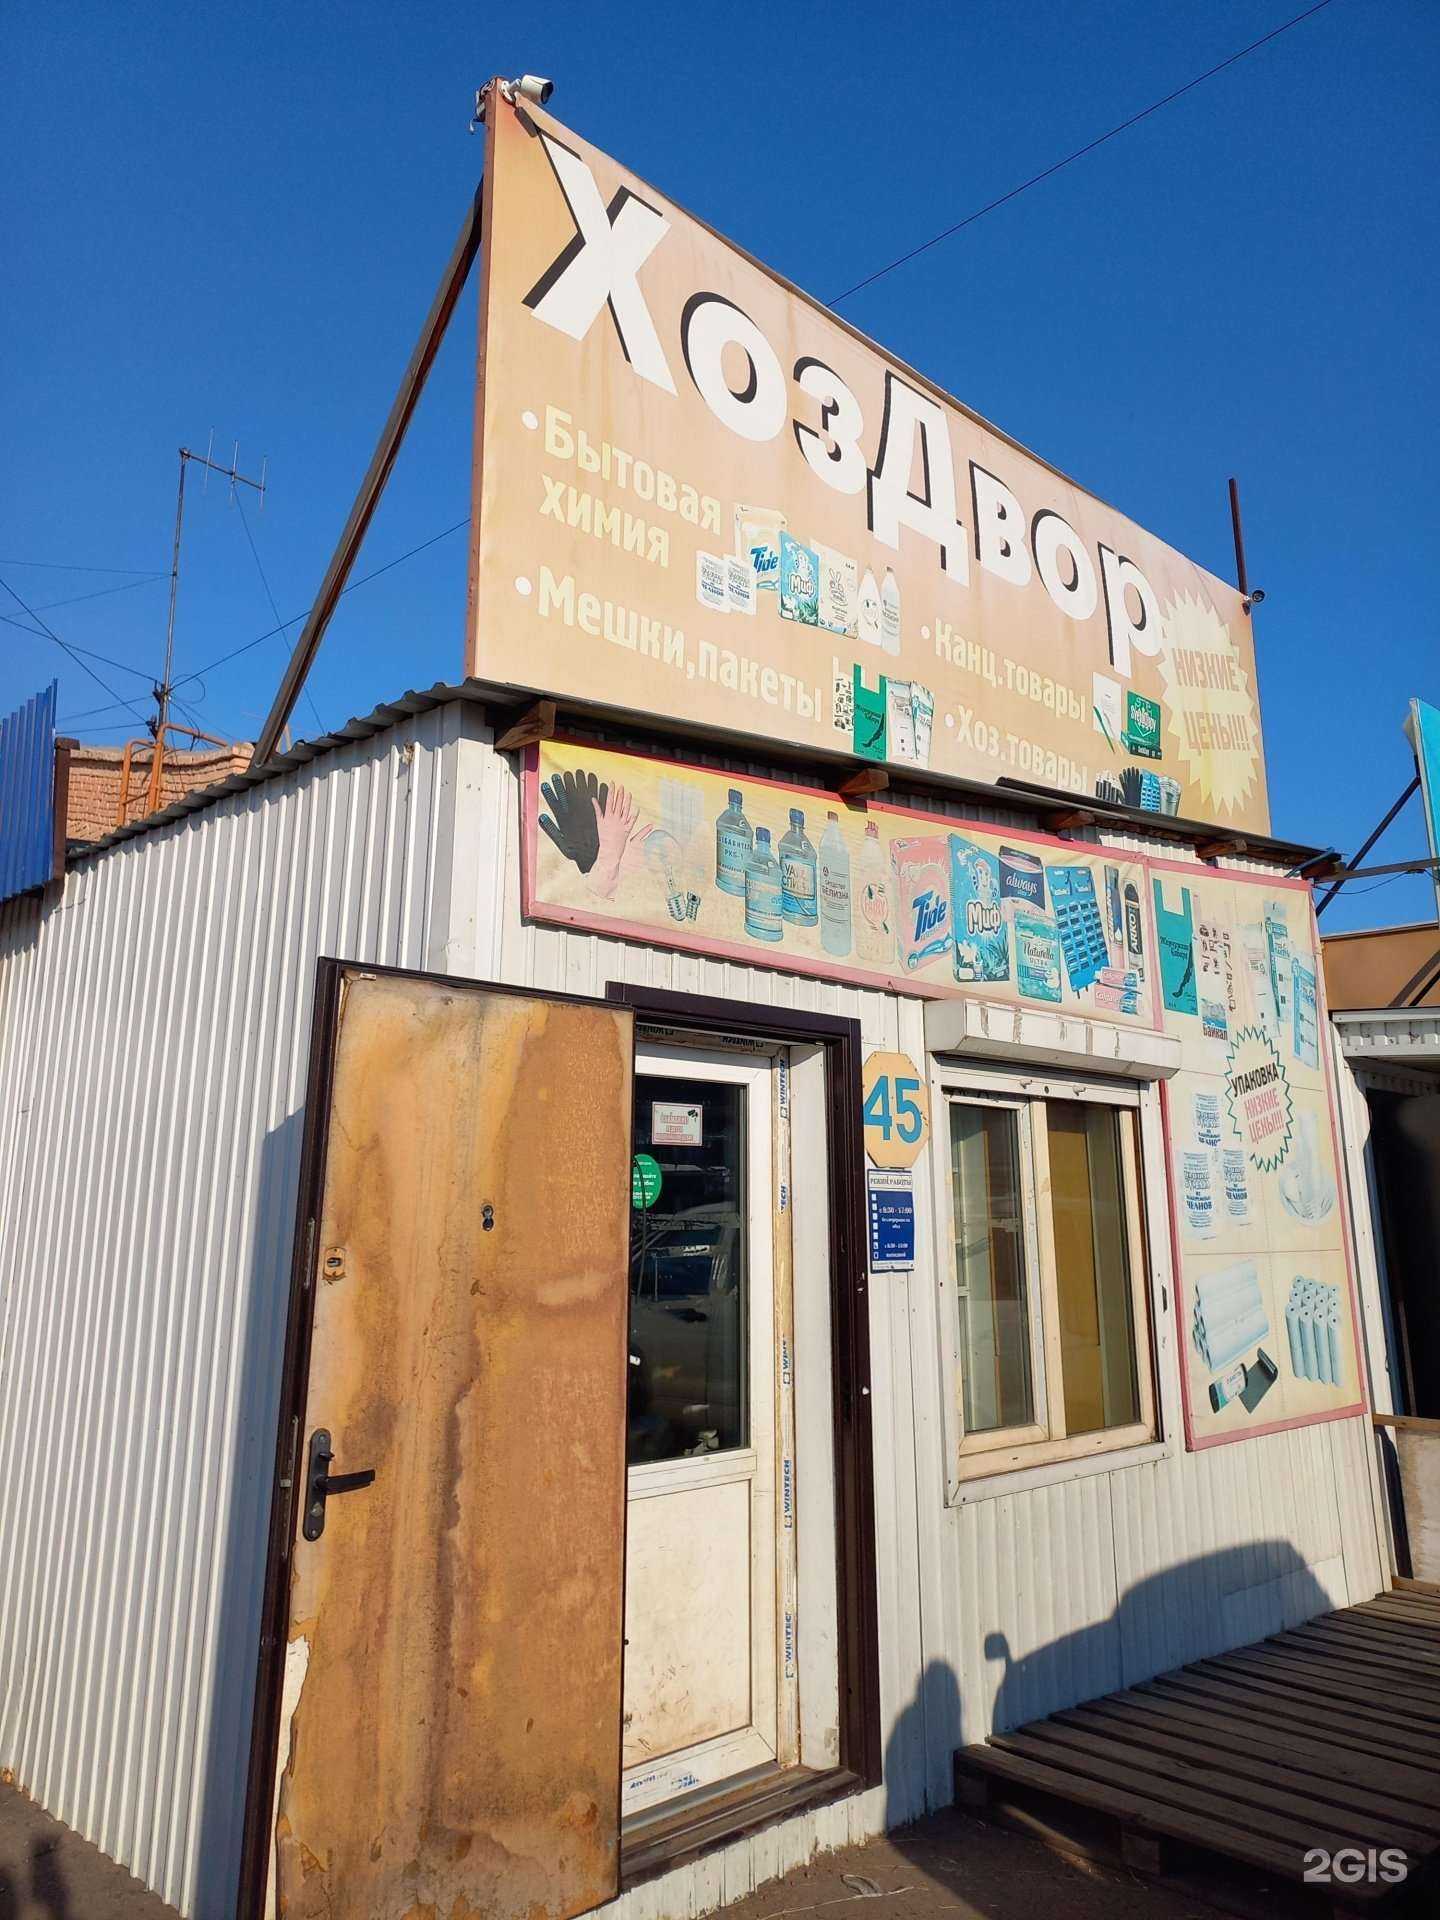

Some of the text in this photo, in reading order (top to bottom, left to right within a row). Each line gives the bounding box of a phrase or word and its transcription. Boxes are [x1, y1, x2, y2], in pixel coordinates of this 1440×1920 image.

[545, 404, 721, 535] Бытовая
[539, 474, 669, 568] химия
[750, 546, 779, 573] Tide
[789, 573, 815, 596] Миф
[935, 618, 1086, 722] Канц.товары
[957, 704, 1088, 792] Хоз.товары
[1006, 875, 1038, 896] always
[912, 890, 947, 942] Tide
[967, 901, 1001, 935] Миф
[779, 1059, 787, 1104] WINTECH
[1231, 1062, 1279, 1098] УПАКОВКА
[863, 1075, 923, 1144] 45
[783, 1459, 792, 1514] WINTECH
